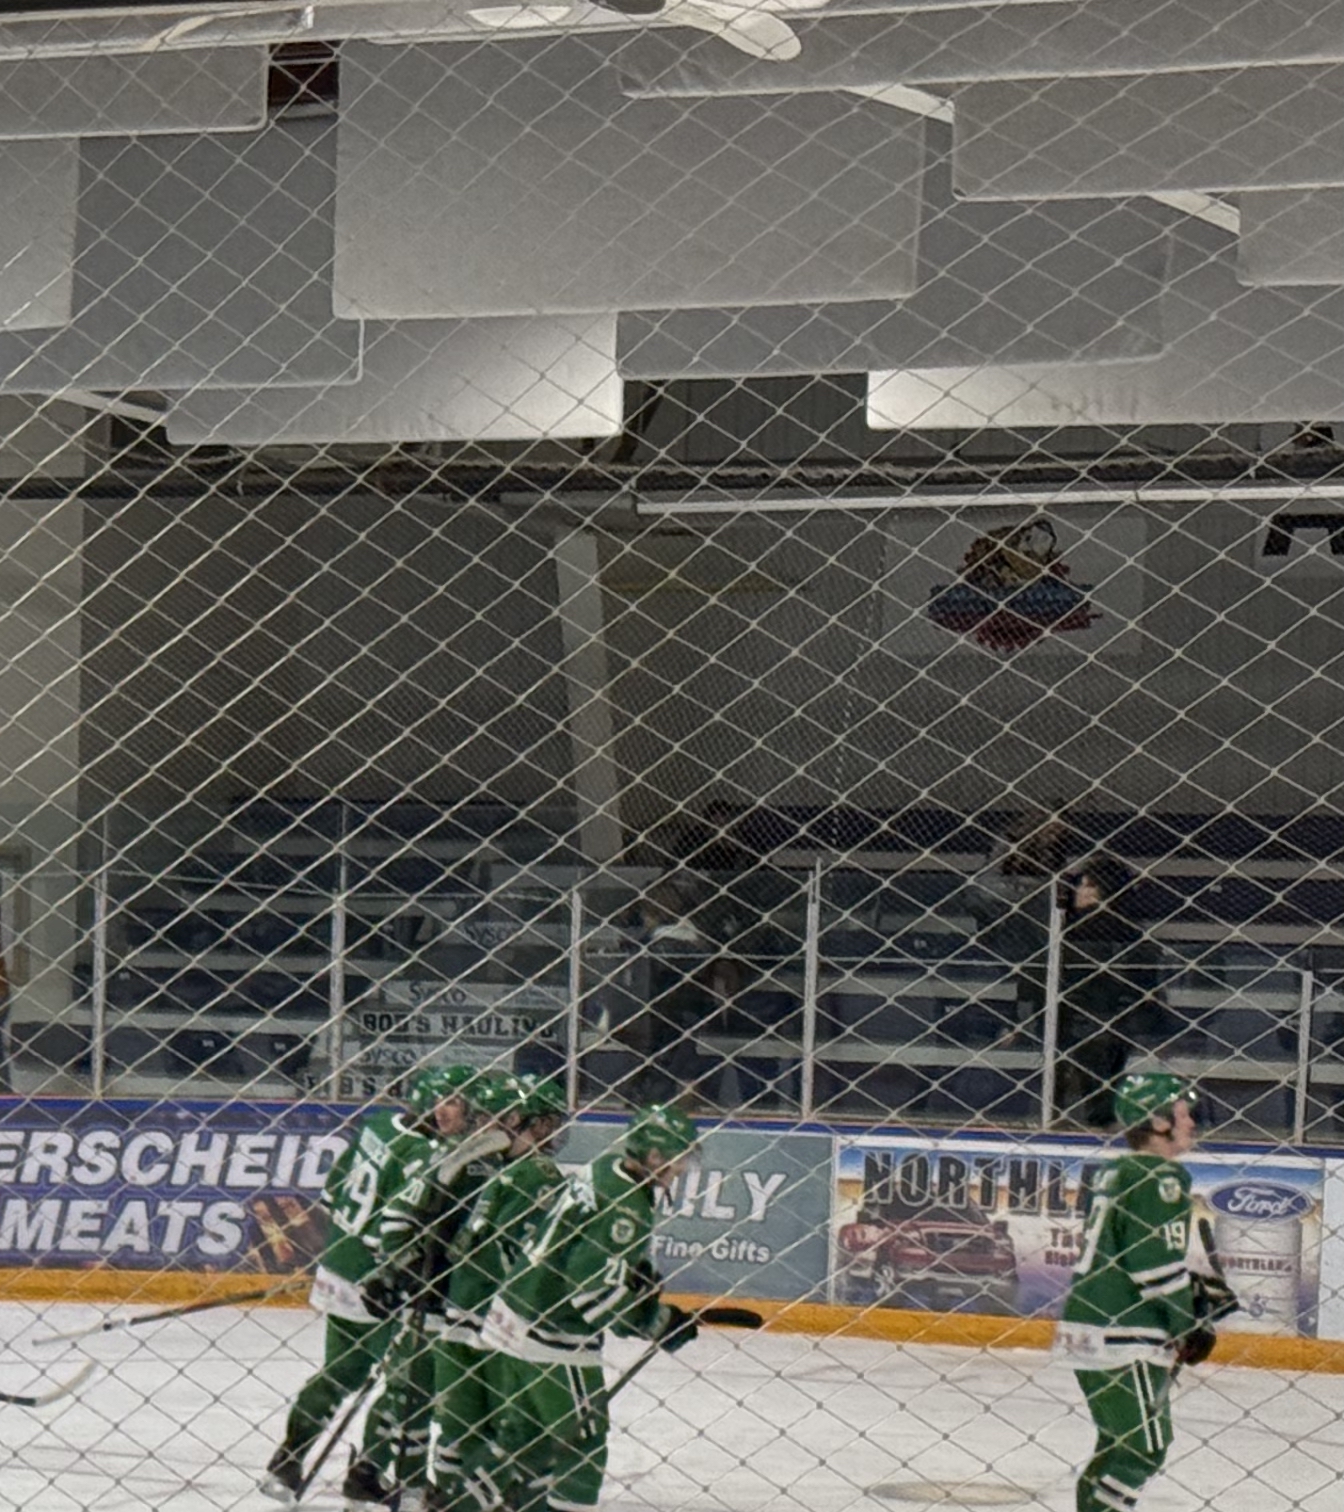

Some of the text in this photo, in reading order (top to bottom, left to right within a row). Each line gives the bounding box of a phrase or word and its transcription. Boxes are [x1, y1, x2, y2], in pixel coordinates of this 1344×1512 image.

[1227, 1186, 1292, 1216] Ford
[712, 1237, 772, 1264] Gifts
[1163, 1220, 1186, 1251] 19
